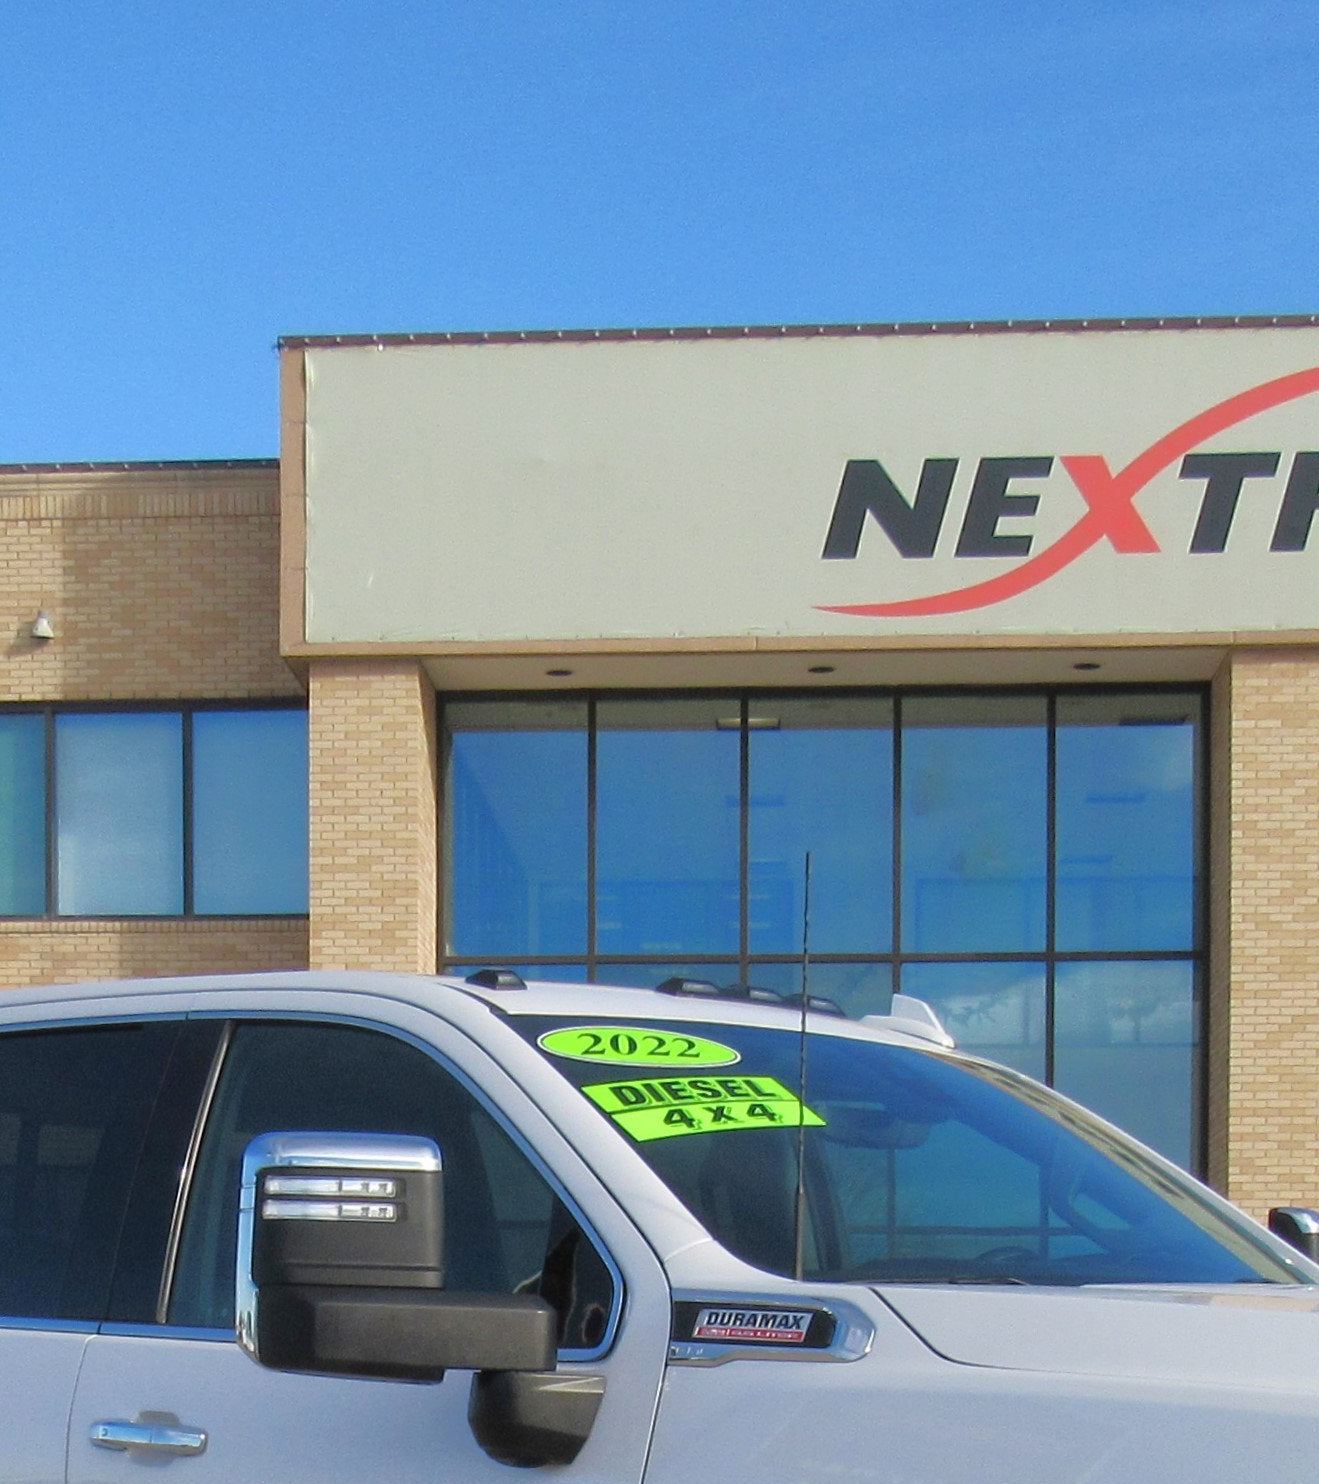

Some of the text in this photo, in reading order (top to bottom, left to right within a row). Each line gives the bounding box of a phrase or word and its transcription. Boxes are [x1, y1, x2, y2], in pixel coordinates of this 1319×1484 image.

[577, 1032, 701, 1059] 2022
[608, 1079, 777, 1107] DIESEL
[706, 1311, 805, 1330] DURAMAX
